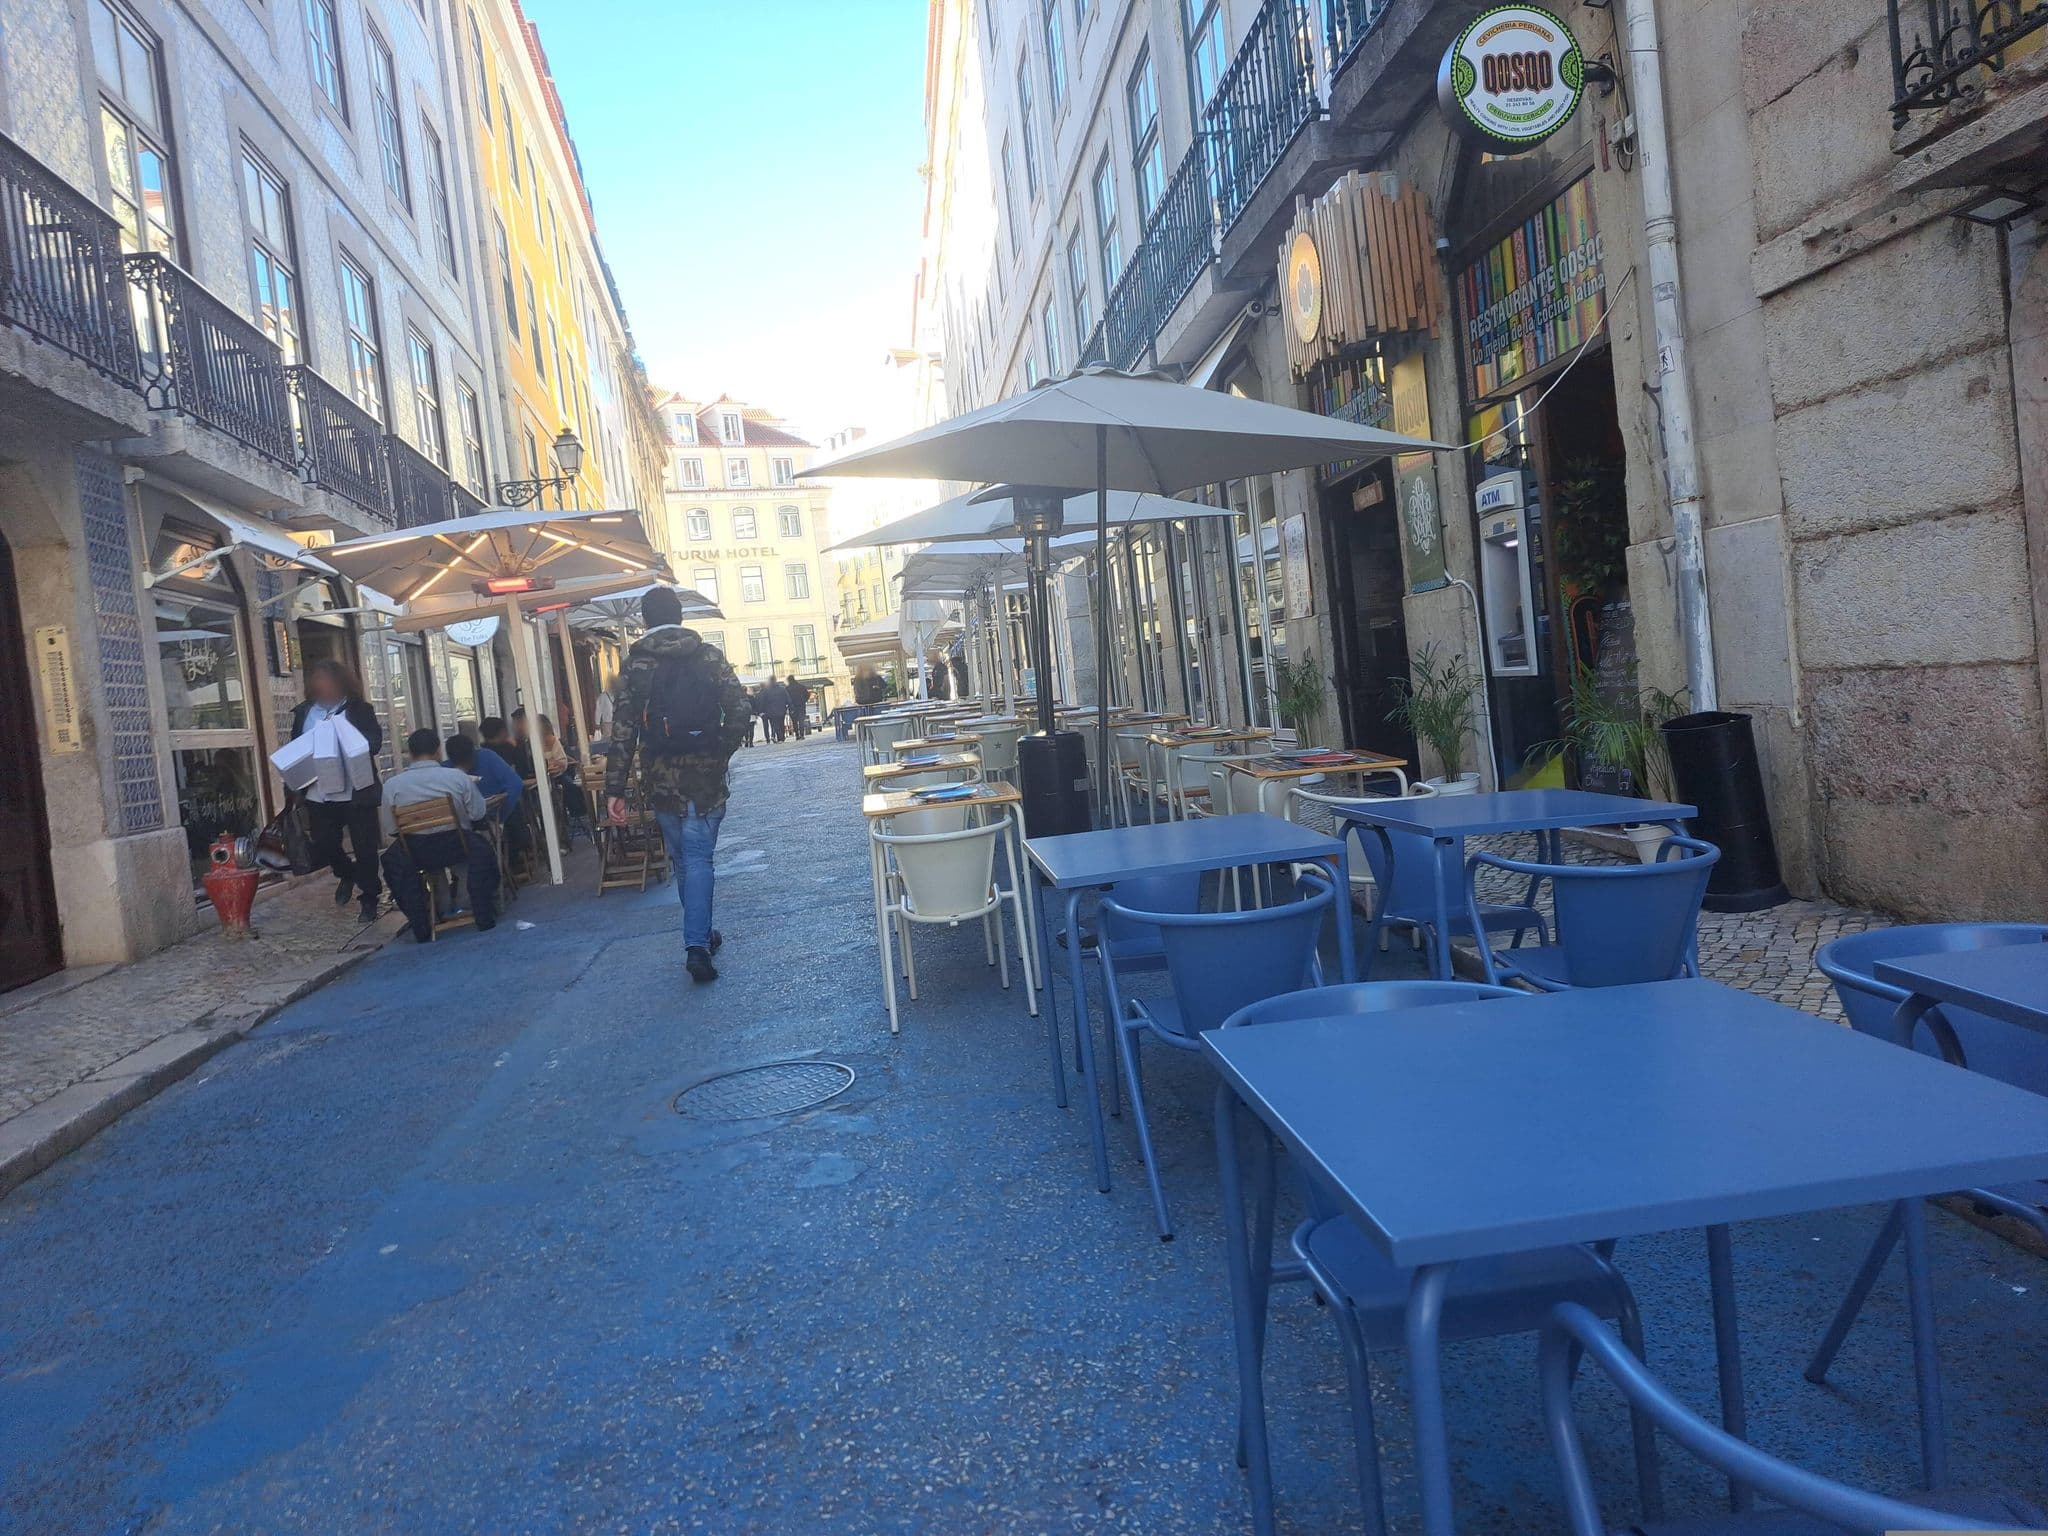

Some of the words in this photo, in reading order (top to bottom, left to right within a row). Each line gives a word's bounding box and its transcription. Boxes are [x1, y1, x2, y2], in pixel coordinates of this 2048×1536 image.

[1518, 22, 1551, 40] PERUANA
[1482, 51, 1553, 96] QOSQO
[1469, 266, 1556, 342] RESTAURANTE
[1472, 348, 1483, 365] Lo
[1484, 333, 1510, 358] mejor
[1511, 323, 1522, 342] de
[1523, 315, 1535, 334] la
[1536, 296, 1570, 326] cocina
[1573, 272, 1606, 305] latina
[1481, 489, 1501, 507] ATM
[726, 547, 780, 559] HOTEL
